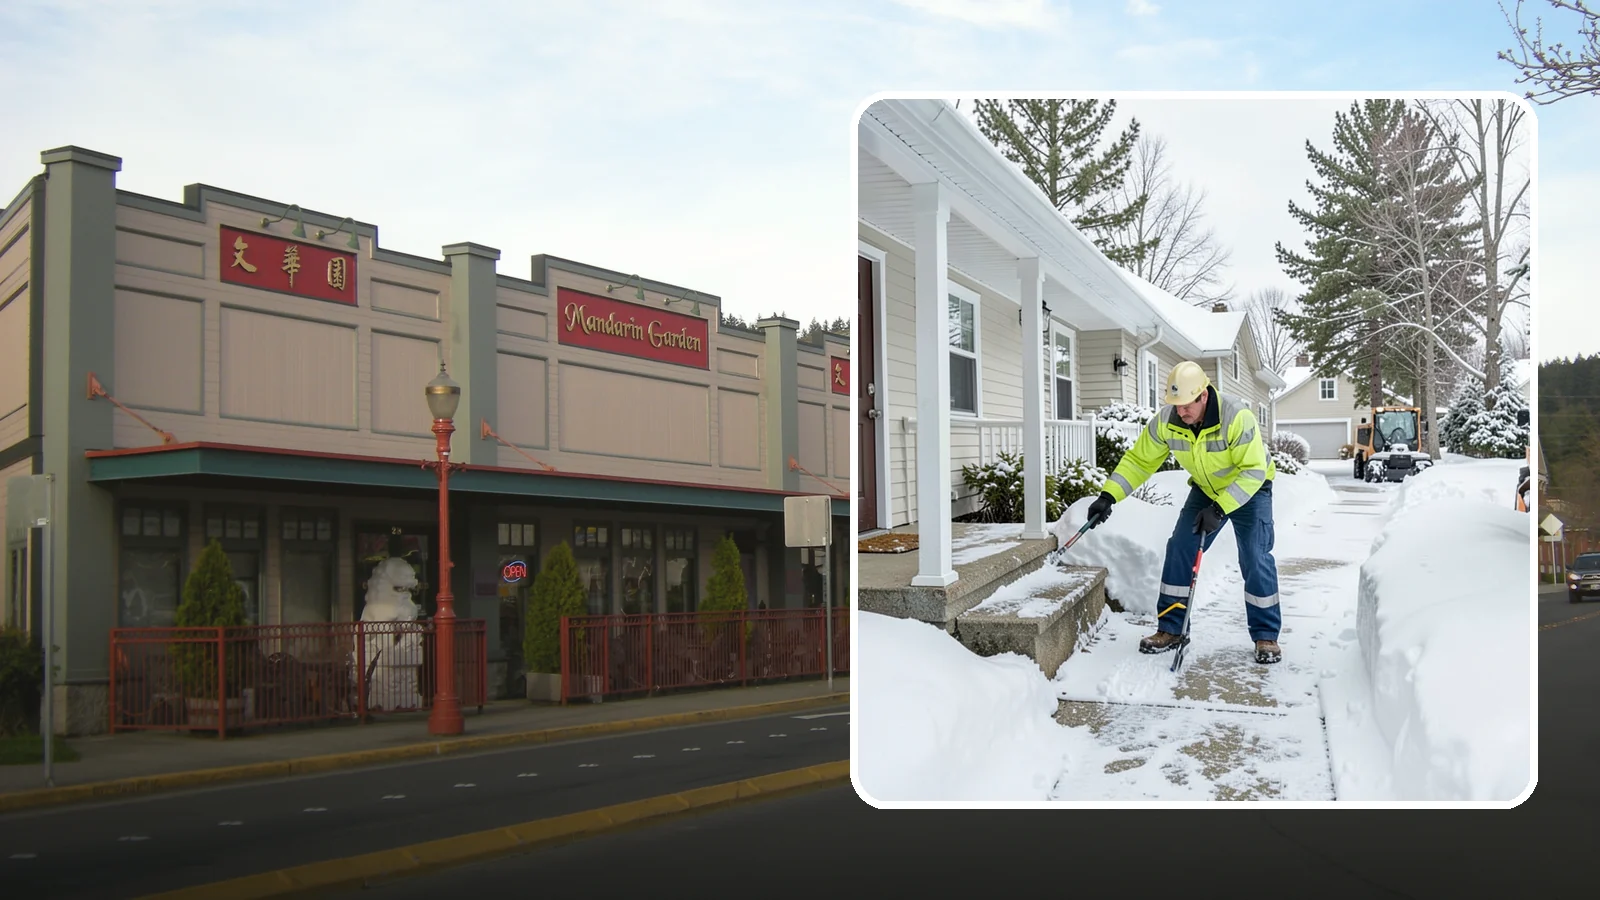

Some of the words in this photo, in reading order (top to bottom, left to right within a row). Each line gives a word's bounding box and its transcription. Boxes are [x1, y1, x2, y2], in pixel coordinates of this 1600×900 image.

[230, 236, 346, 291] 文華園
[564, 301, 645, 341] Mandarin
[647, 319, 702, 353] Garden
[503, 564, 527, 579] OPEN
